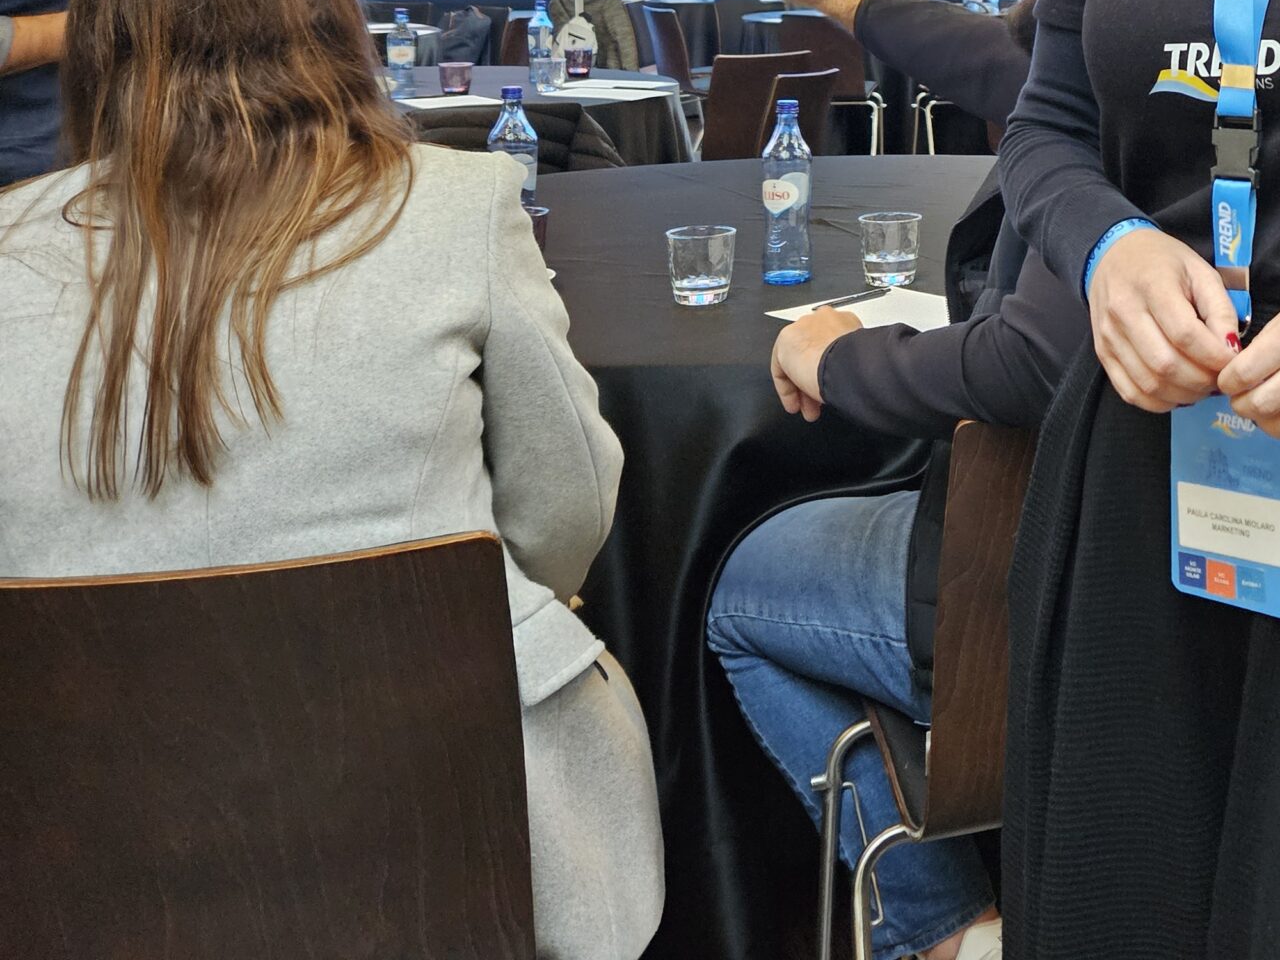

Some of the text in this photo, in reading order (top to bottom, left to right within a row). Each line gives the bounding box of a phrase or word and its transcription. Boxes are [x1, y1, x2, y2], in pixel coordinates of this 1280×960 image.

[1218, 201, 1232, 256] TREND
[1216, 411, 1257, 432] TREND
[1211, 522, 1251, 538] MARKETING
